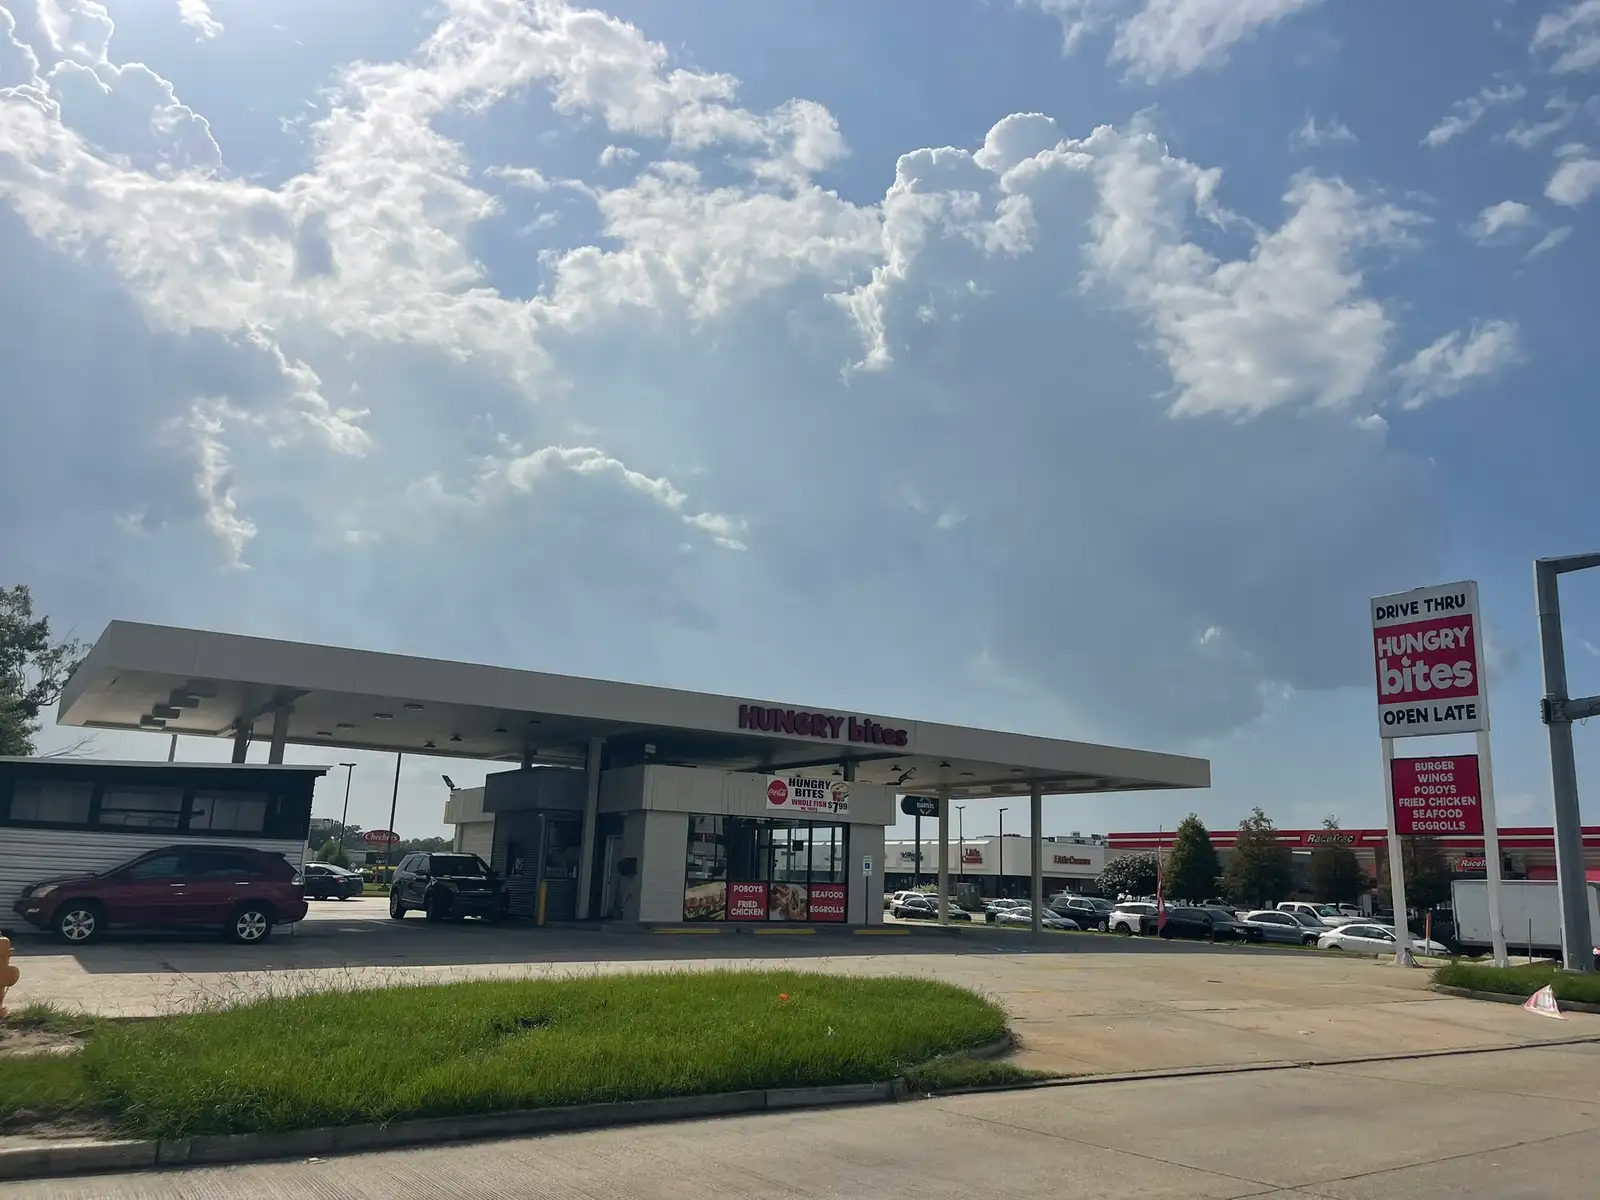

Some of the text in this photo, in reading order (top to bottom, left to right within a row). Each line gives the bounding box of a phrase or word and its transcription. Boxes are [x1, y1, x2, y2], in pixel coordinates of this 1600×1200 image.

[1376, 594, 1465, 620] DRIVE THRU
[1377, 626, 1470, 657] HUNGRY
[1380, 656, 1473, 695] bites
[1384, 704, 1476, 725] OPEN LATE
[739, 704, 908, 746] HUNGRY bites
[1415, 761, 1455, 771] BURGER
[1417, 773, 1454, 782] WINGS
[788, 778, 831, 790] HUNGRY
[795, 788, 824, 798] BITES
[1414, 785, 1456, 795] POBOYS
[1399, 796, 1476, 807] FRIED CHICKEN
[1413, 809, 1463, 818] SEAFOOD
[1412, 821, 1466, 831] EGGROLLS
[733, 885, 763, 893] POBOYS
[811, 890, 844, 899] SEAFOOD
[737, 900, 758, 908] FRIED
[731, 908, 764, 916] CHICKEN
[809, 905, 844, 914] EGGROLLS
